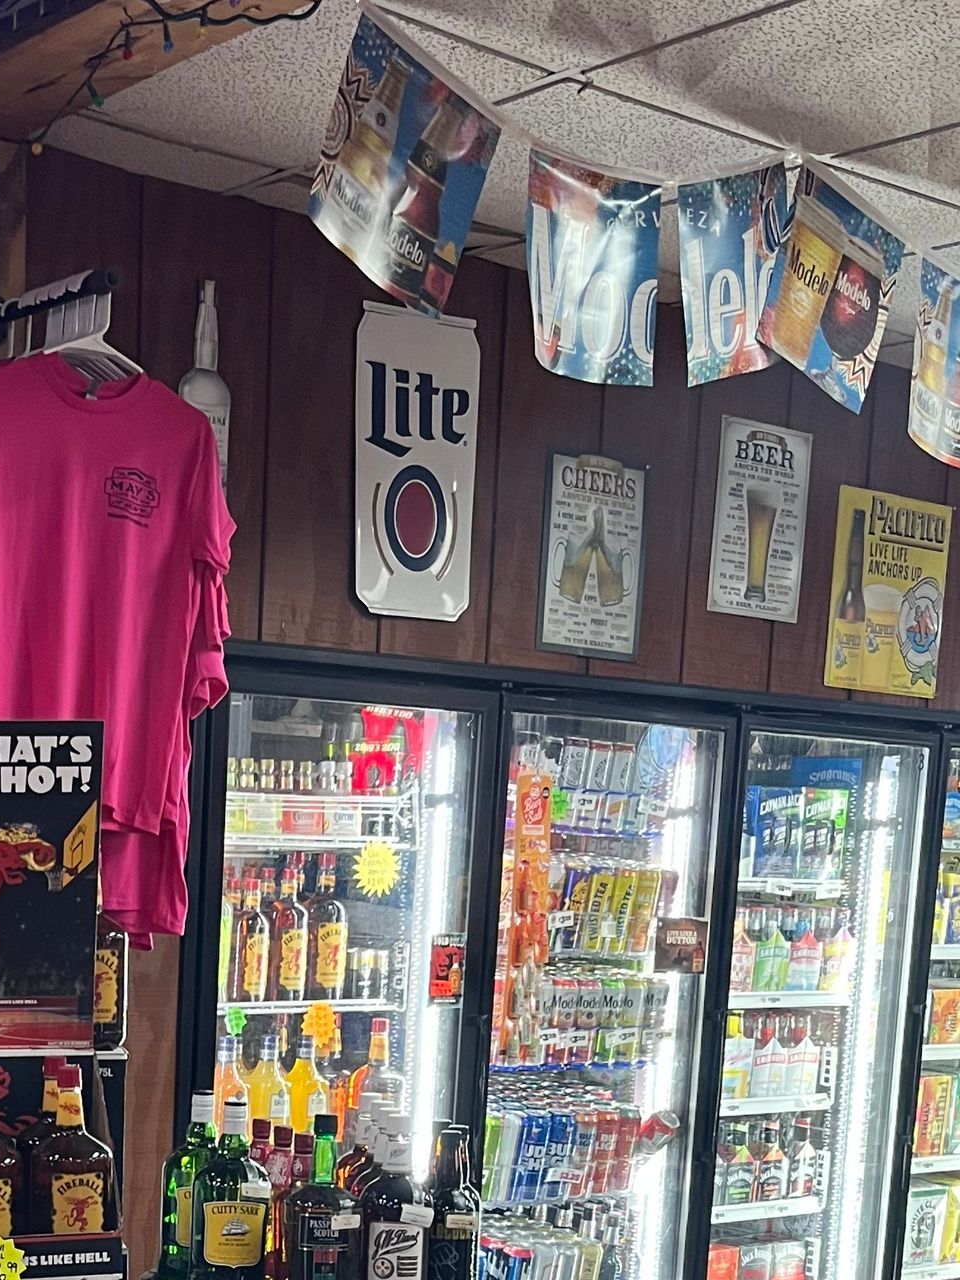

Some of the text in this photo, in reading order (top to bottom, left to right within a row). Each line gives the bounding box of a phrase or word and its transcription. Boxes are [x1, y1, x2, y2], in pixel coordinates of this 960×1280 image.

[790, 242, 829, 297] Modelo
[835, 270, 871, 312] Modelo
[364, 360, 470, 458] Lite
[735, 439, 795, 471] BEER
[111, 480, 156, 502] MAY'S
[561, 465, 637, 500] CHEERS
[868, 495, 947, 545] PACIFICO
[869, 542, 908, 563] LIVE LIFE
[868, 559, 923, 583] ANCHORS UP
[809, 768, 857, 784] Seagram's
[760, 795, 788, 816] CAYMAN
[589, 881, 608, 943] TWISTED TEA
[666, 936, 697, 945] DUTTON
[56, 1176, 105, 1198] FIREBALL
[211, 1205, 261, 1216] CUTTY SARK
[910, 1204, 924, 1233] WHITE
[310, 1218, 331, 1229] PASSP
[313, 1228, 340, 1238] SCOTCH
[40, 1253, 73, 1266] LIKE
[75, 1252, 111, 1263] HELL
